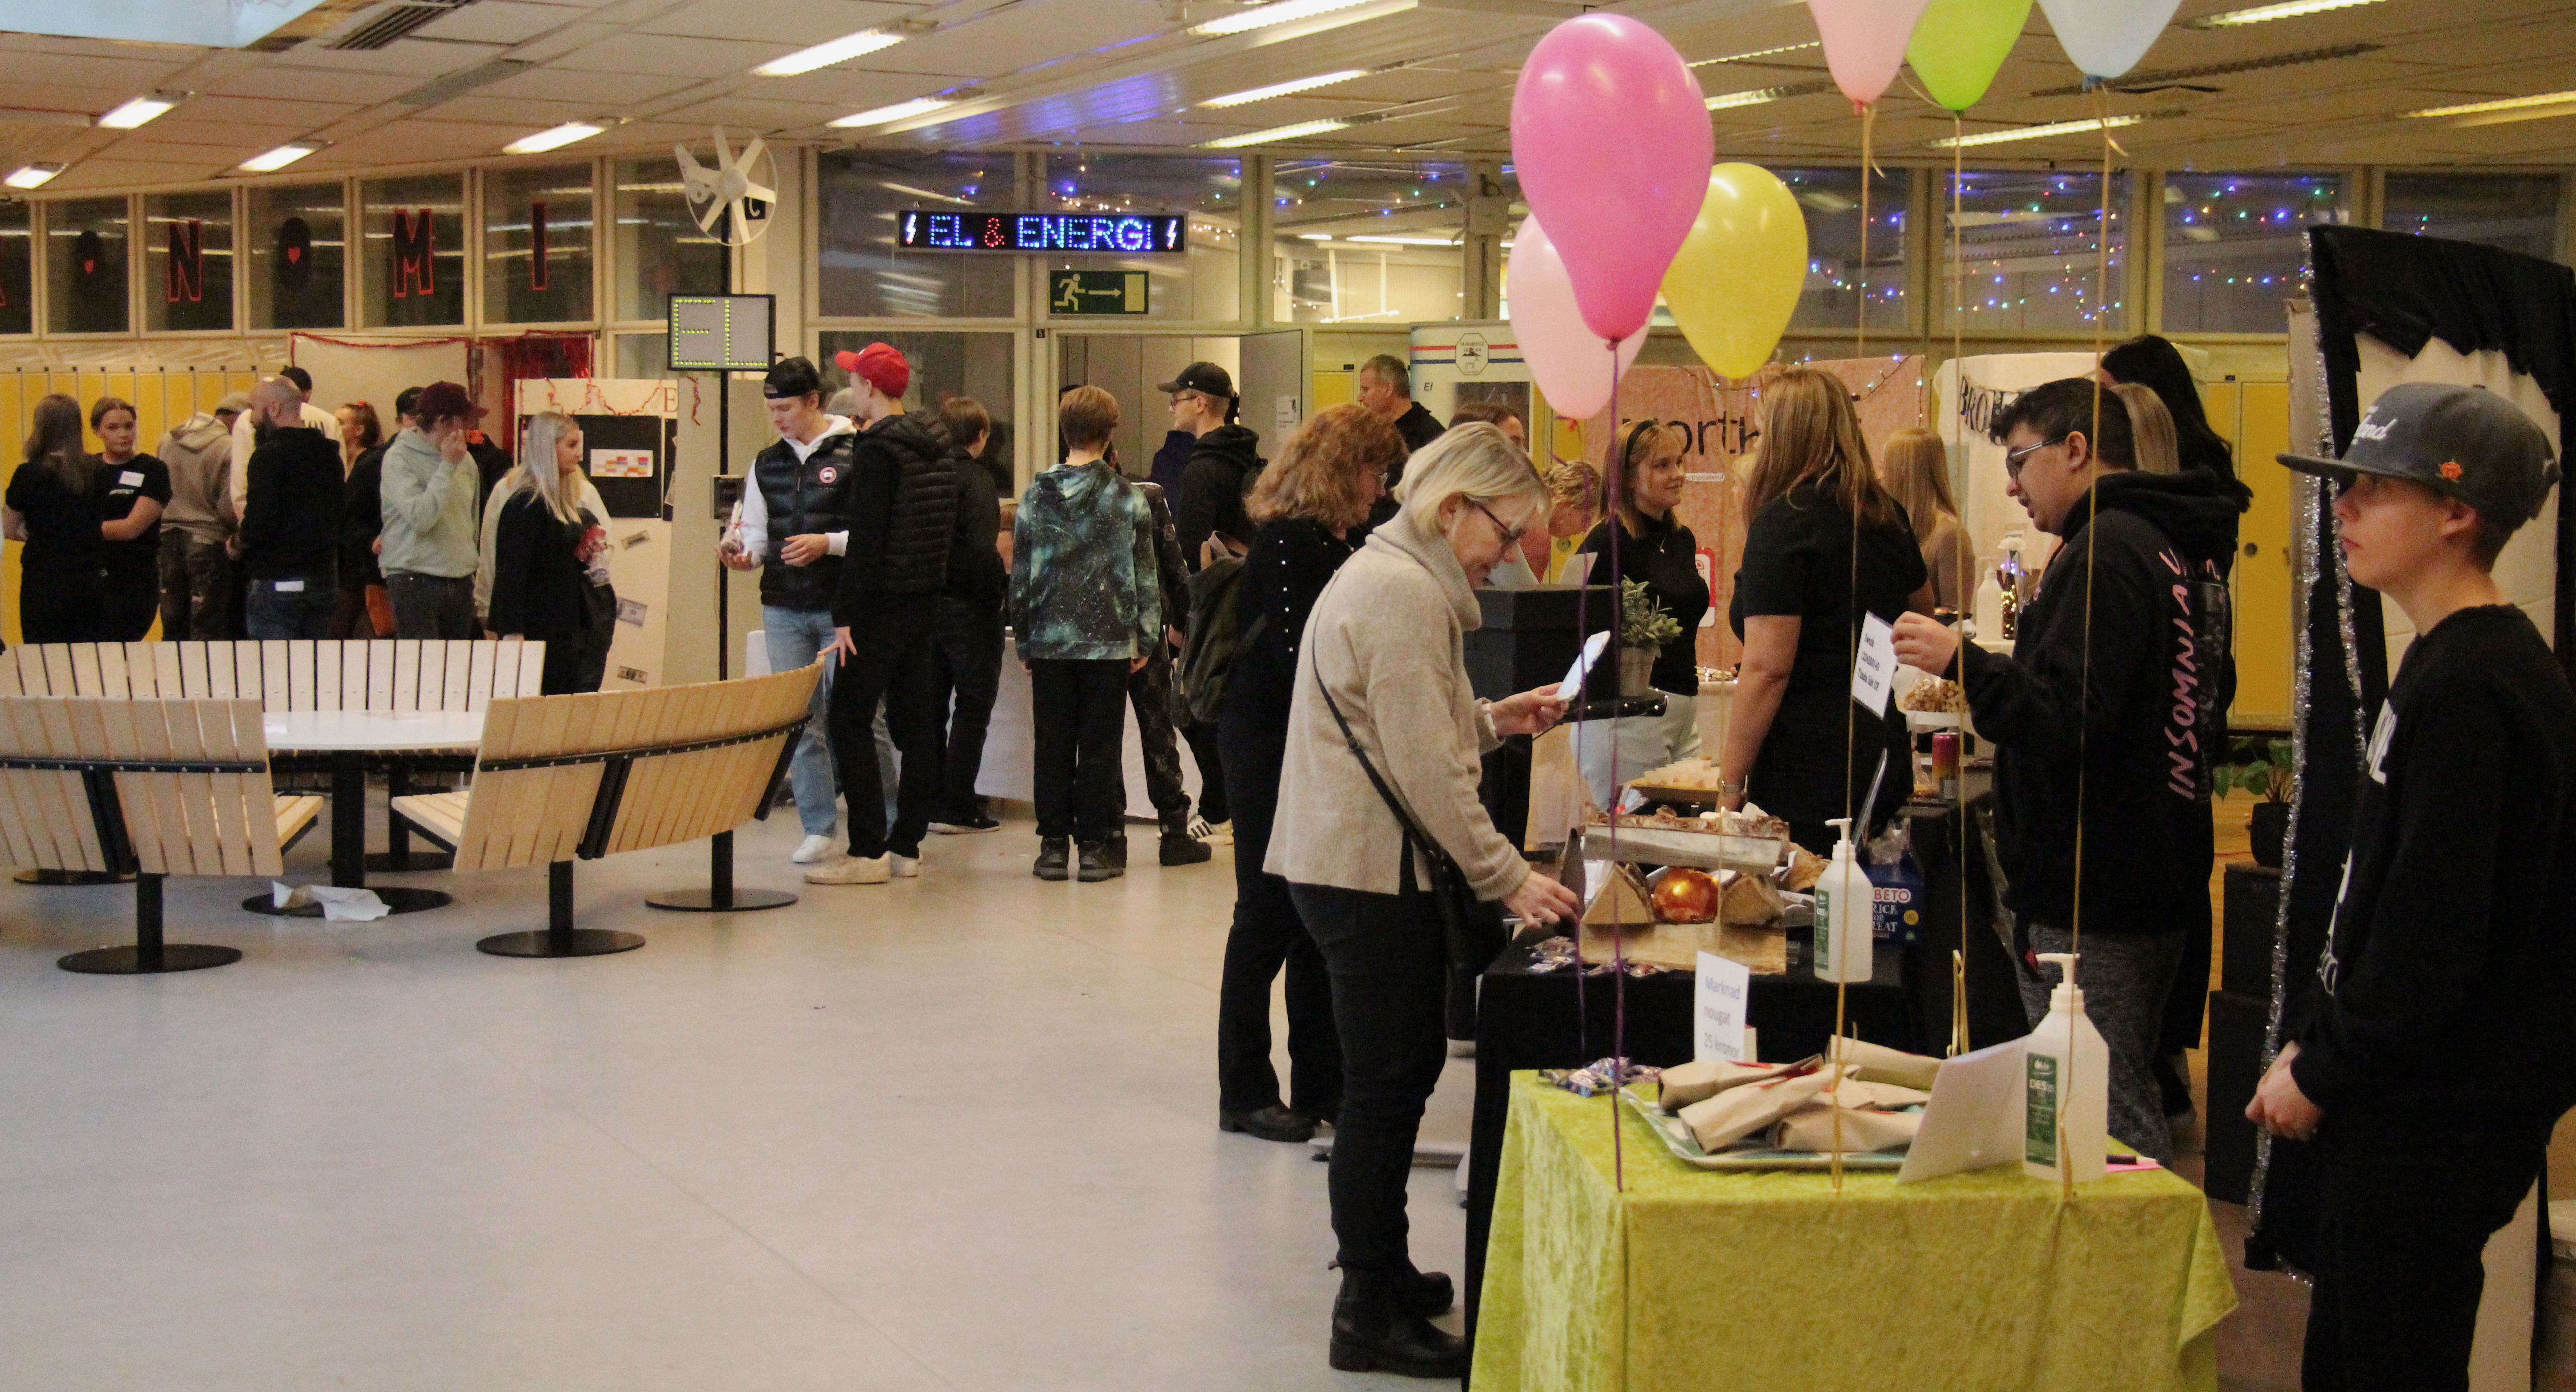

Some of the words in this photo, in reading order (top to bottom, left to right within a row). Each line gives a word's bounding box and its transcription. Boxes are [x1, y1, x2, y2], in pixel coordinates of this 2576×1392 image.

[929, 215, 973, 247] EL
[983, 217, 1005, 248] &
[1016, 216, 1153, 251] ENERGI
[673, 298, 768, 366] EL
[1874, 888, 1909, 901] BETO
[1872, 903, 1898, 915] RICK
[1872, 921, 1897, 932] REAT
[1705, 975, 1741, 1000] Marknad
[1703, 1006, 1731, 1026] nougat
[1704, 1032, 1713, 1049] 25
[1714, 1035, 1740, 1059] kronor
